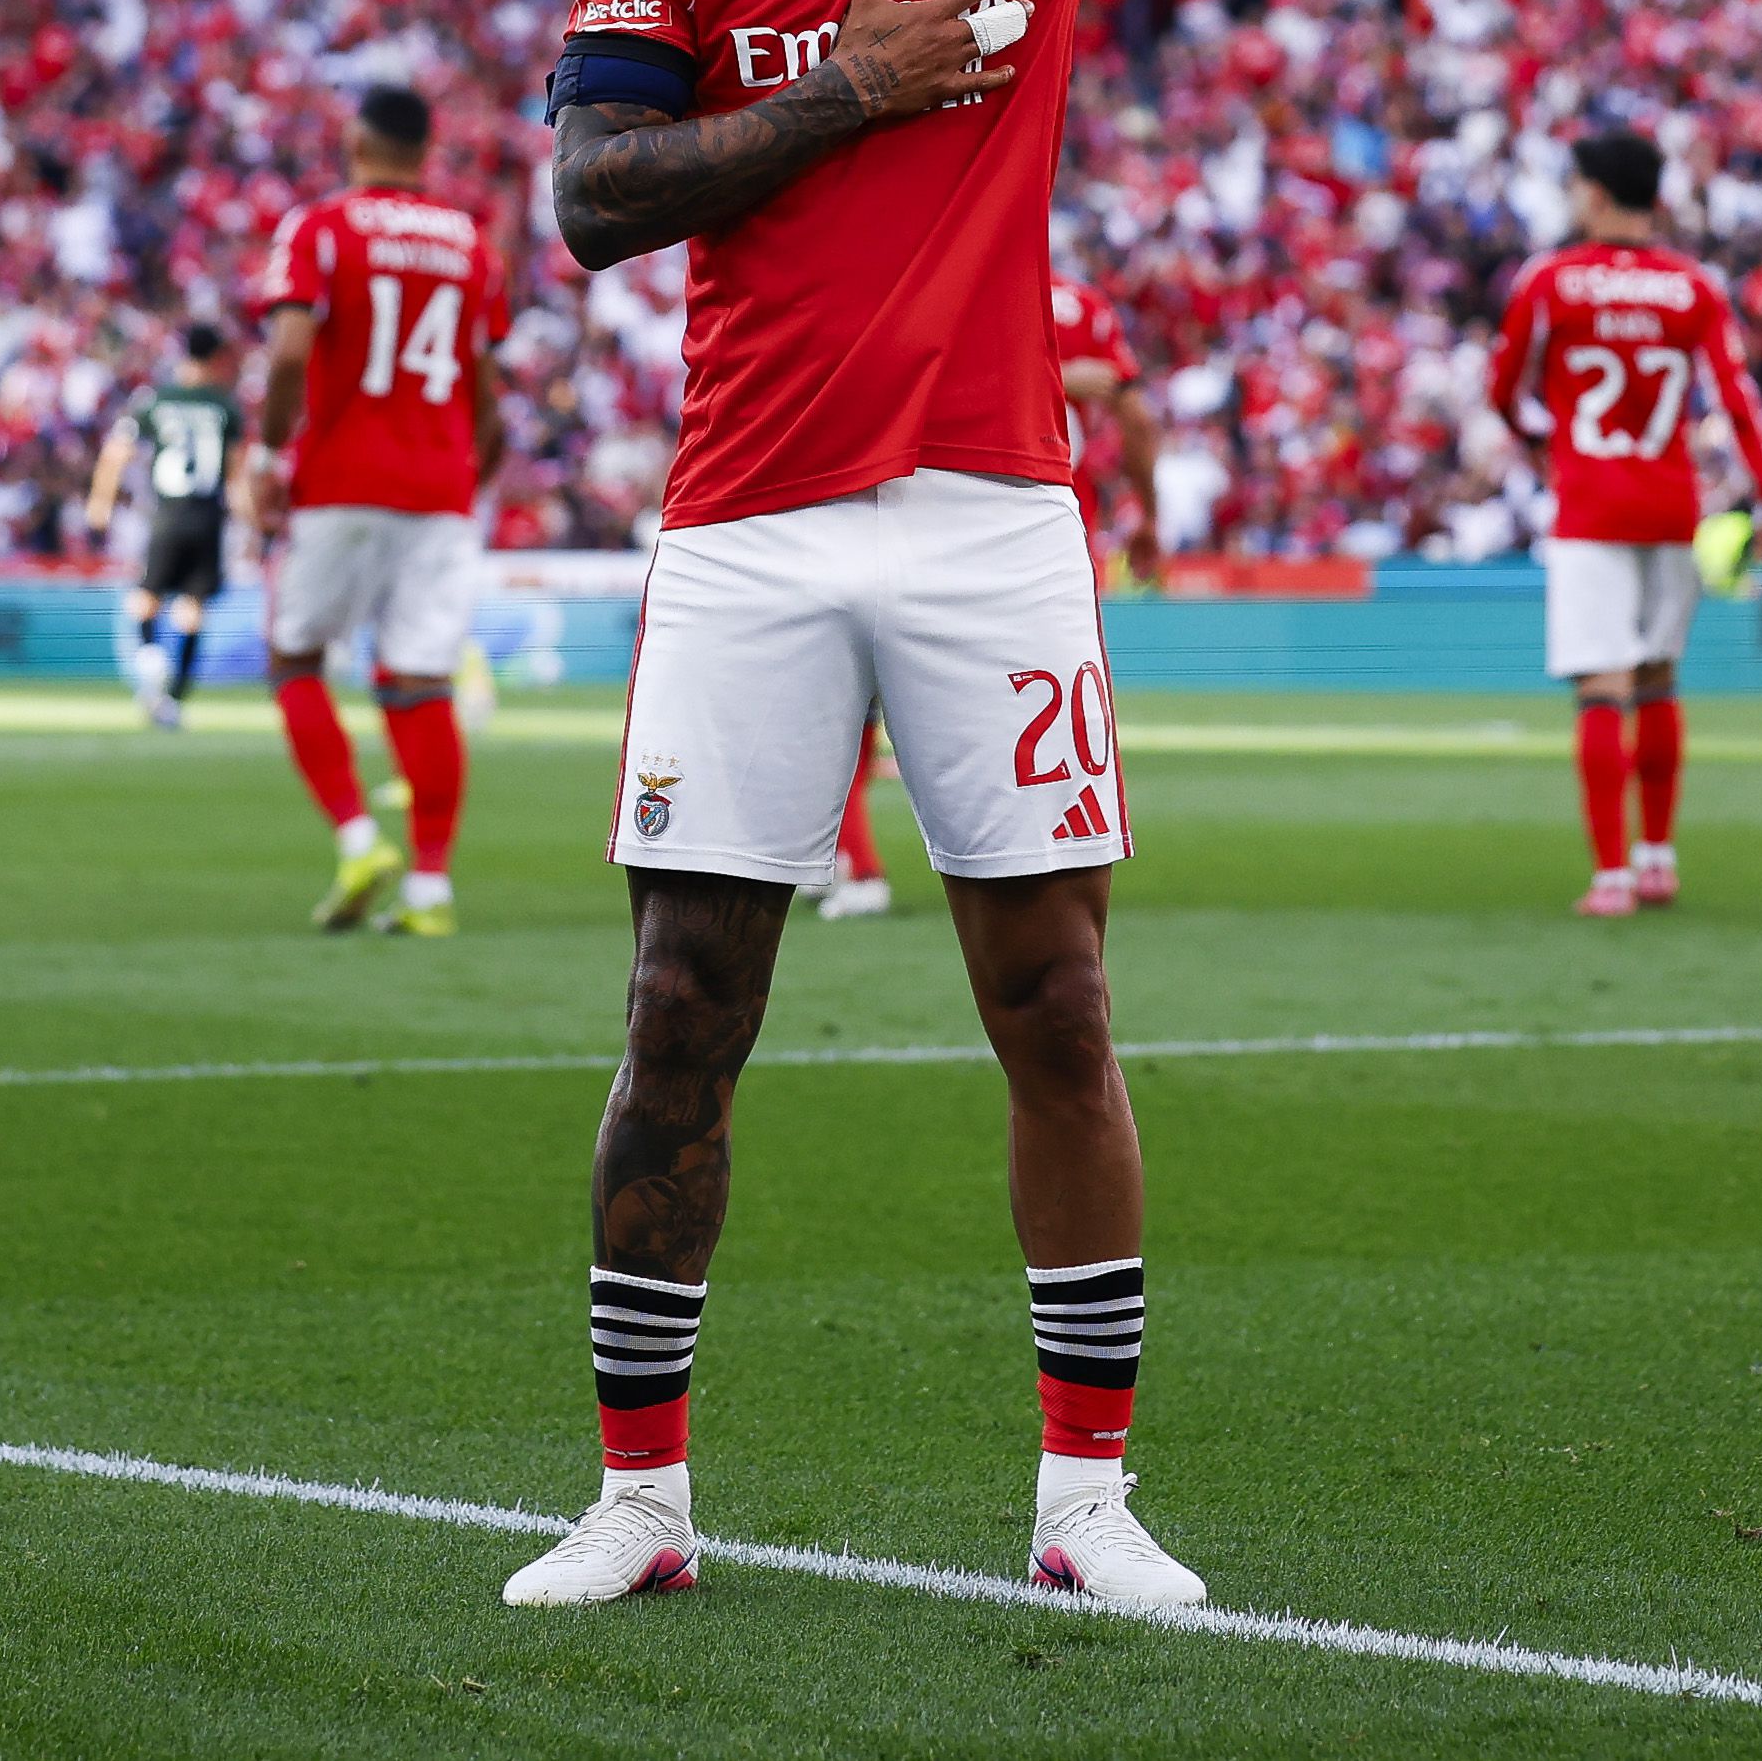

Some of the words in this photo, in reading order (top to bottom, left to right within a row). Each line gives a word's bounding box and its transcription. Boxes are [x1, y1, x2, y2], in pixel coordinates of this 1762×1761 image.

[359, 274, 464, 405] 14
[1564, 345, 1689, 460] 27
[1006, 660, 1111, 789] 20
